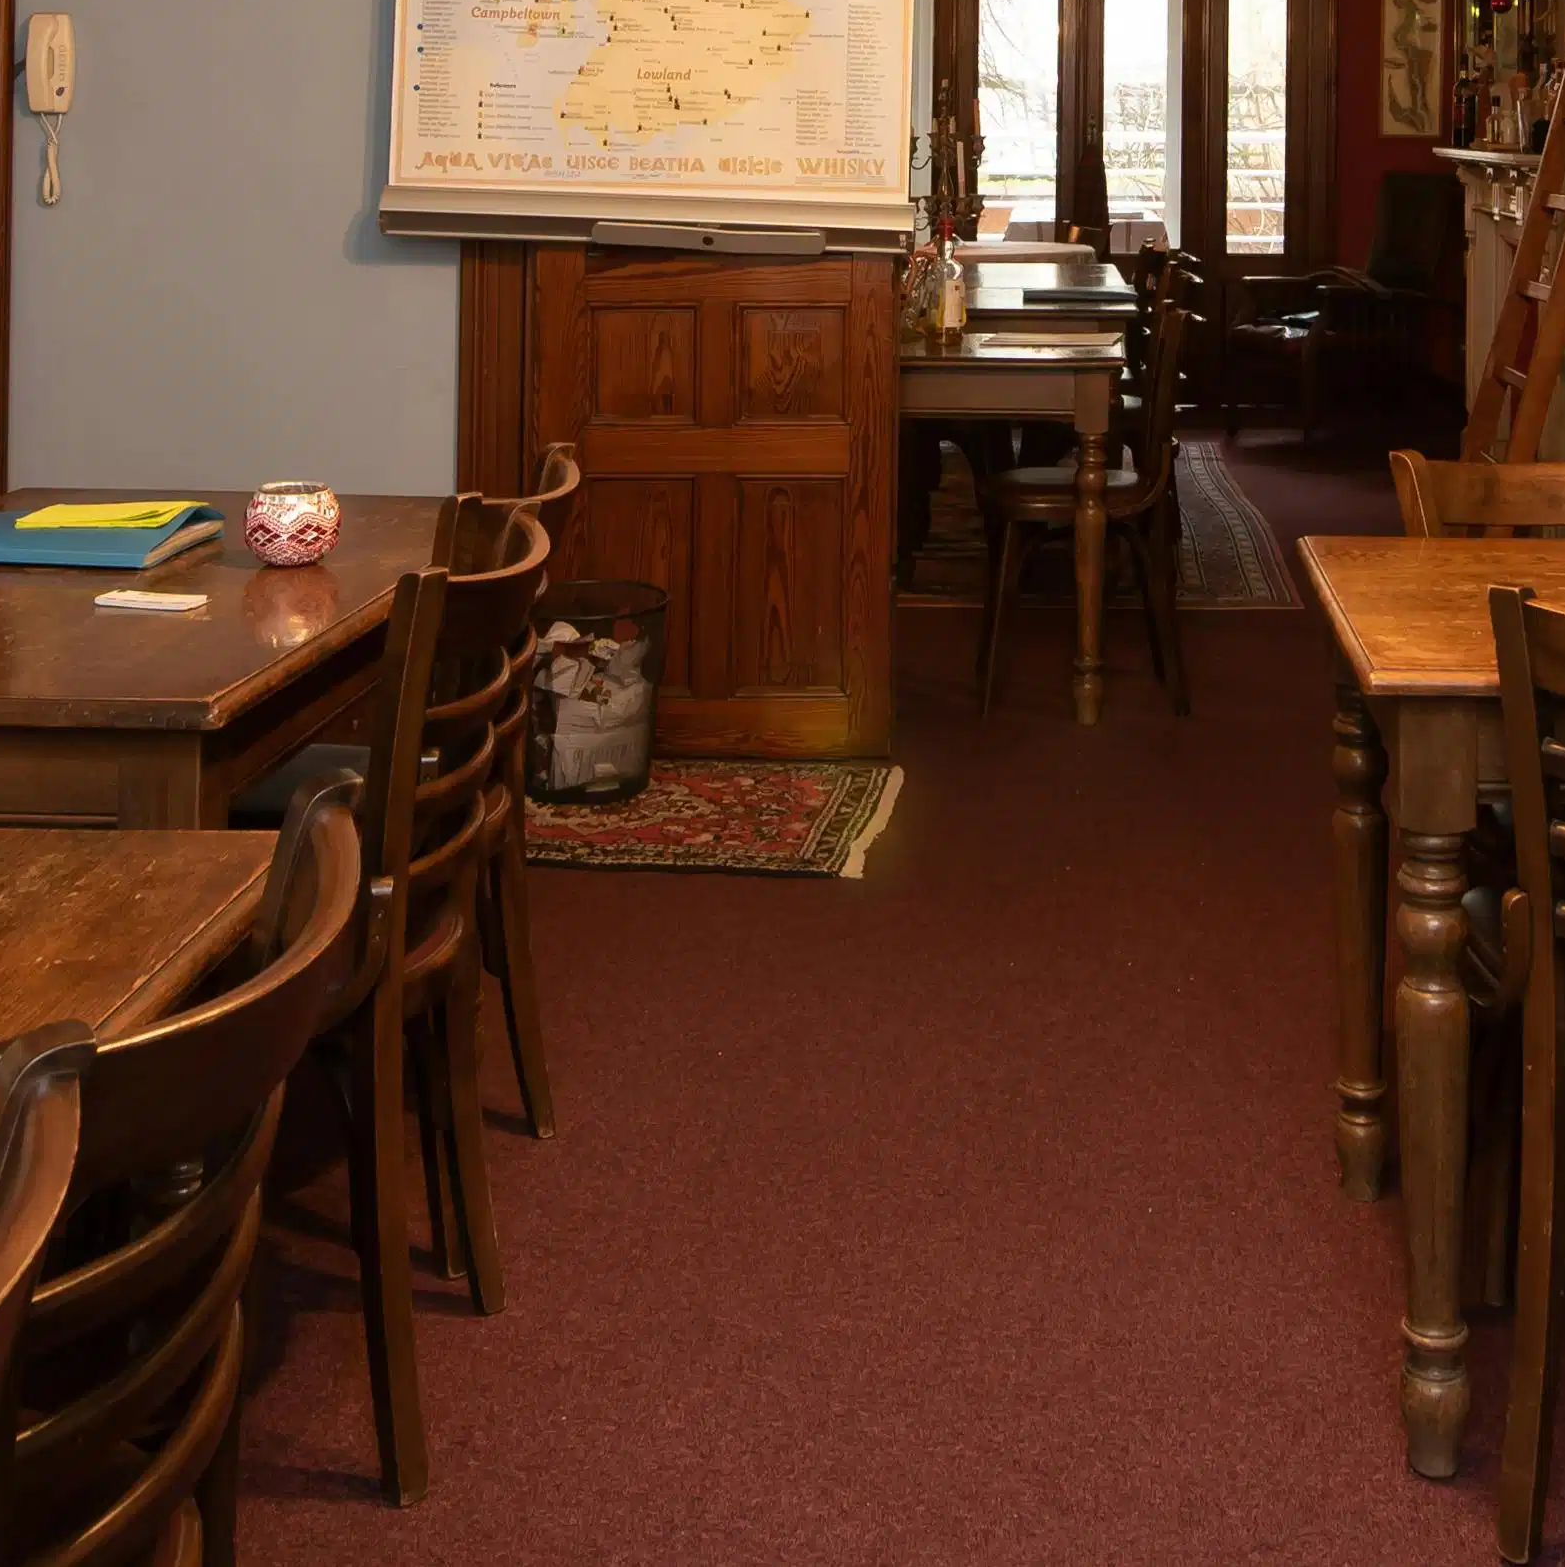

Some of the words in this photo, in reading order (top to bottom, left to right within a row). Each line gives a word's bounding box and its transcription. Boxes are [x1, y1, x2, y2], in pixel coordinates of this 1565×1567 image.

[471, 7, 560, 20] Campbeltown
[637, 68, 691, 80] Lowland
[796, 157, 885, 175] WHISKY
